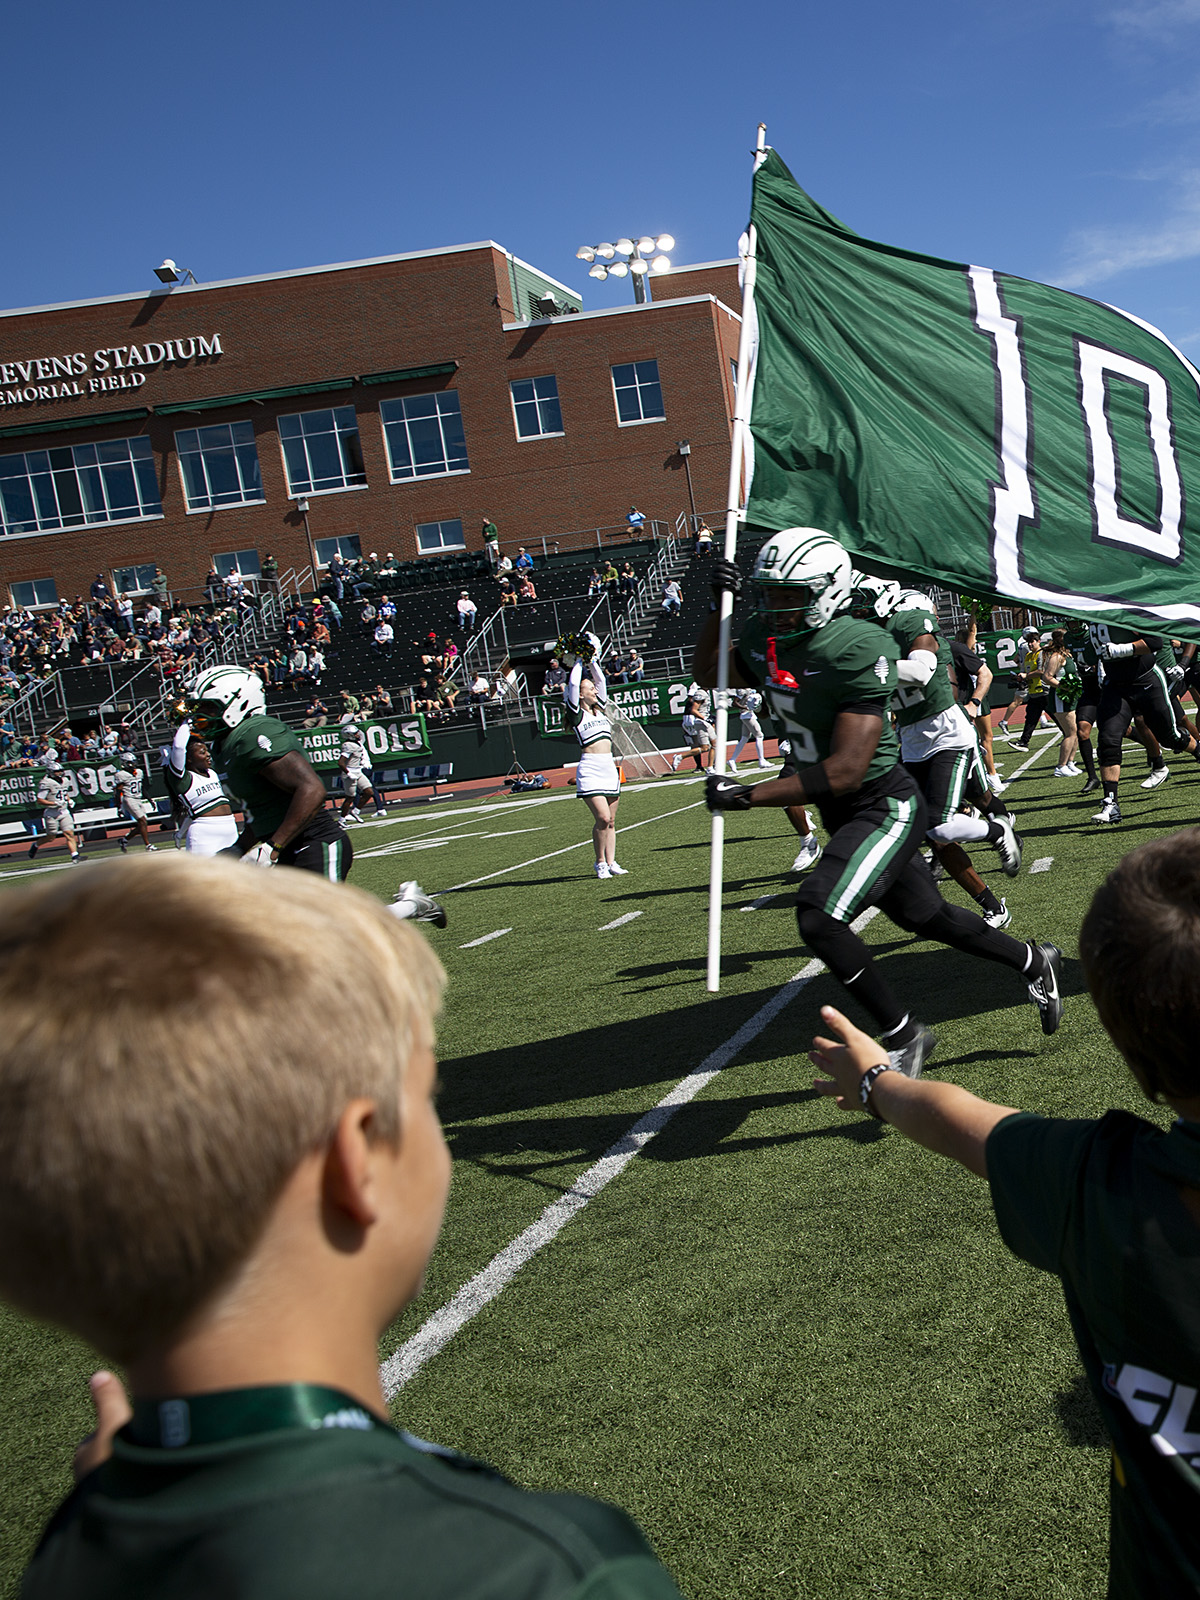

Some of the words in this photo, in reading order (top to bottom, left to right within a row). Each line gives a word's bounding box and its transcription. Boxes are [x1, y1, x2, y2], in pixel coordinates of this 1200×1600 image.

[0, 352, 88, 385] EVENS
[94, 333, 224, 371] STADIUM
[88, 372, 146, 393] FIELD
[299, 733, 341, 749] AGUE
[360, 721, 423, 755] 015
